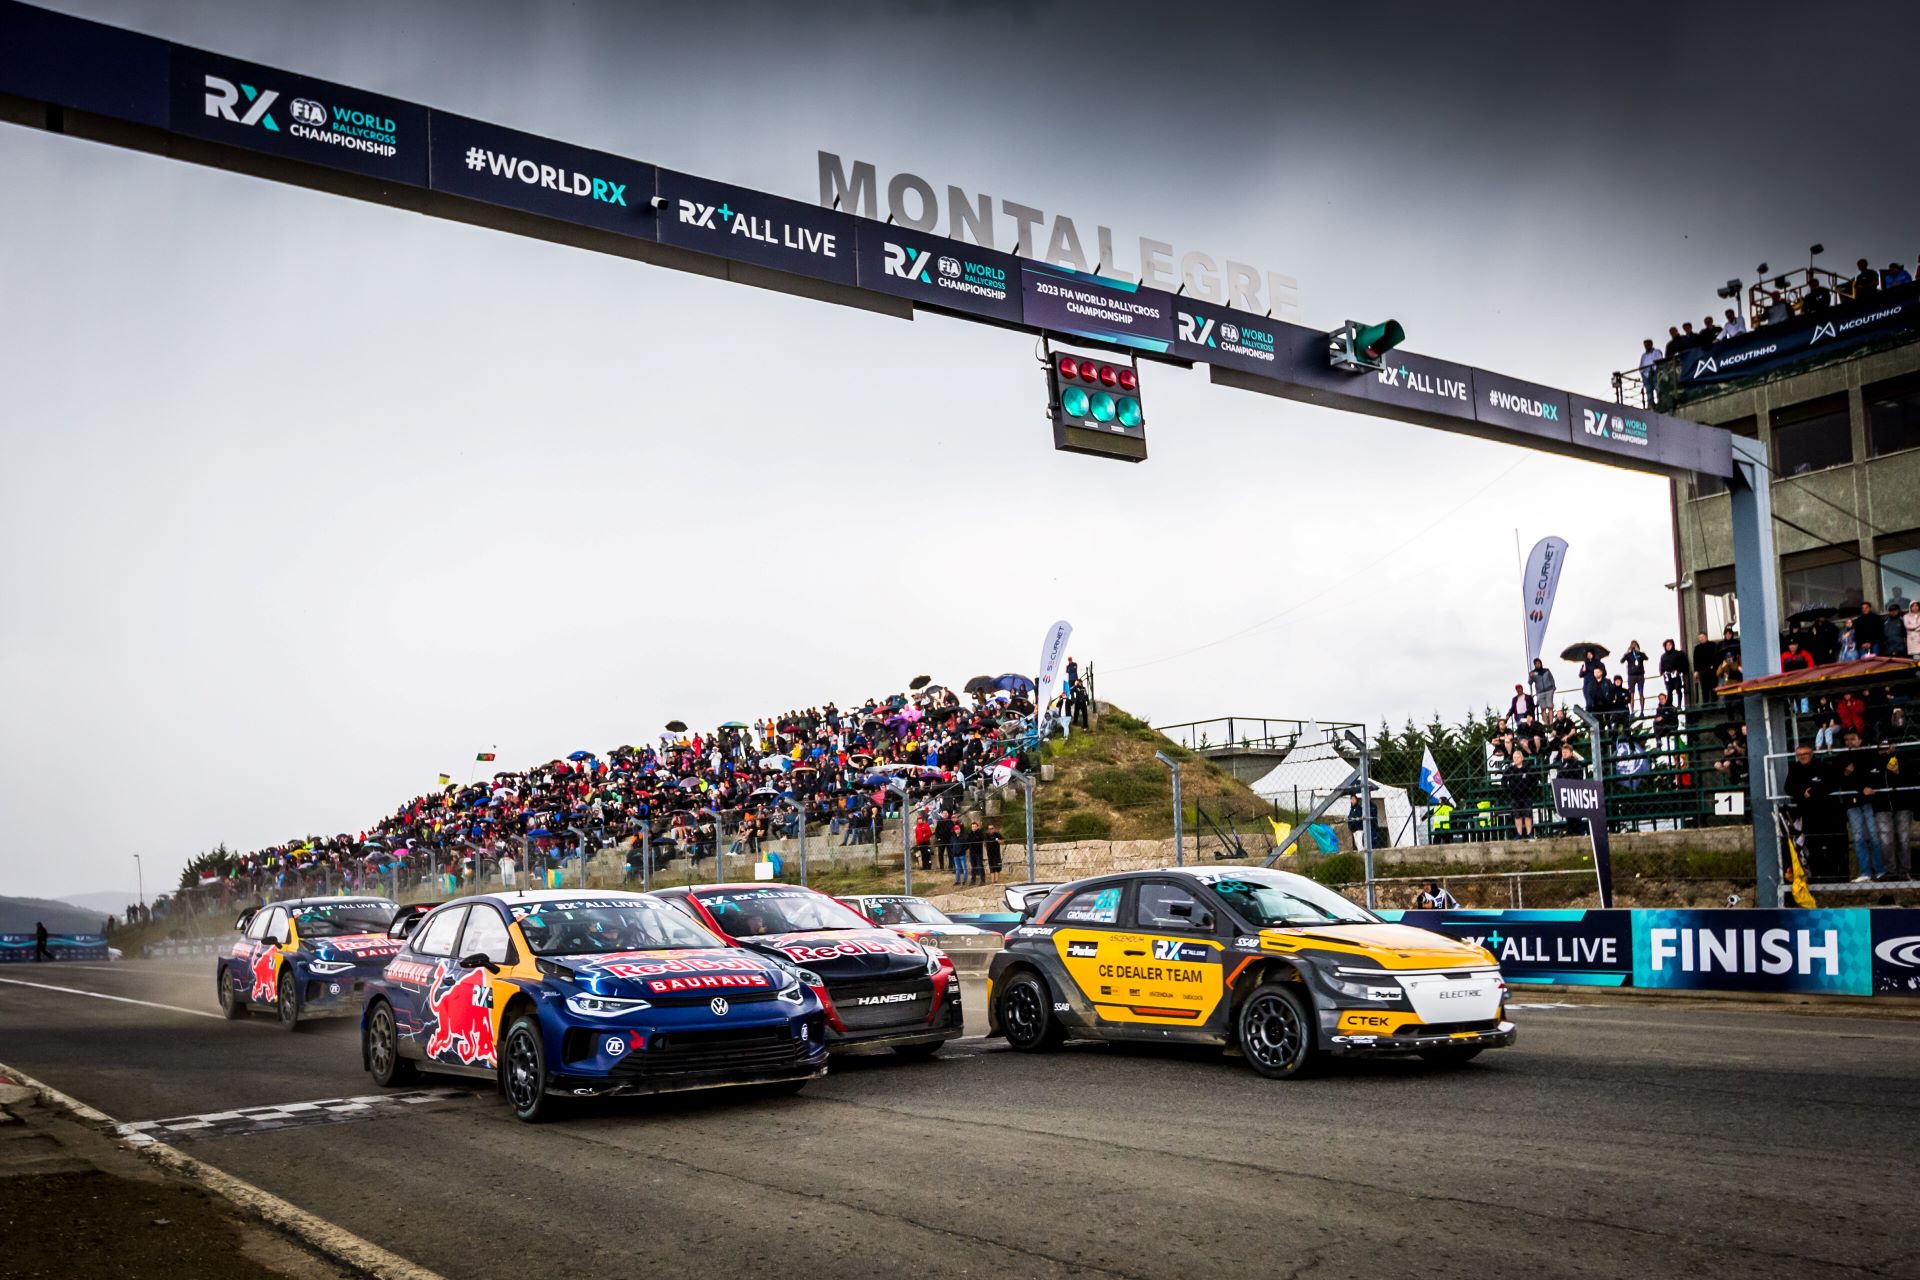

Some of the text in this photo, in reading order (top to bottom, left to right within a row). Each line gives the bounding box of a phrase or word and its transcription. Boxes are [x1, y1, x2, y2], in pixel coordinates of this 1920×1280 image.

[205, 75, 280, 131] RX
[292, 101, 325, 125] FIA
[333, 106, 396, 133] WORLD
[290, 124, 396, 158] CHAMPIONSHIP
[332, 121, 396, 144] RALLYCROSS
[465, 146, 627, 207] #WORLDRX
[731, 212, 778, 244] ALL
[784, 223, 837, 258] LIVE
[817, 149, 1299, 321] MONTALEGRE
[884, 242, 932, 284] RX
[938, 257, 961, 277] FIA
[964, 261, 1006, 281] WORLD
[938, 277, 1007, 300] CHAMPIONSHIP
[964, 273, 1006, 290] RALLYCROSS
[1037, 282, 1160, 319] 2023 FIA WORLD RALLYCROSS
[1066, 302, 1134, 325] CHAMPIONSHIP
[1839, 306, 1903, 333] MCOUTINHO
[1178, 312, 1217, 348] RX
[1221, 325, 1240, 341] FIA
[1241, 327, 1274, 344] WORLD
[1221, 341, 1275, 362] CHAMPIONSHIP
[1241, 337, 1275, 352] RALLYCROSS
[1719, 344, 1777, 369] MCOUTINHO
[1407, 374, 1434, 395] ALL
[1437, 378, 1468, 401] LIVE
[1489, 390, 1559, 422] #WORLDRX
[1584, 408, 1609, 438] RX
[1625, 418, 1647, 432] WORLD
[1611, 431, 1648, 446] CHAMPIONSHIP
[1535, 542, 1555, 605] SECURNET
[1560, 787, 1599, 810] FINISH
[1724, 796, 1733, 812] 1
[613, 900, 644, 908] LIVE
[1095, 888, 1120, 911] 68
[357, 947, 399, 958] BAUH
[783, 944, 863, 964] Red
[865, 941, 928, 957] Bull
[1155, 940, 1184, 961] RX
[1235, 937, 1260, 948] SSAB
[1501, 937, 1550, 963] ALL
[1557, 937, 1617, 963] LIVE
[1650, 928, 1840, 976] FINISH
[604, 955, 766, 979] Red Bull
[1099, 964, 1203, 983] CE DEALER TEAM
[650, 974, 768, 993] BAUHAUS
[1439, 988, 1482, 999] ELECTRIC
[858, 993, 917, 1005] HANSEN
[1053, 1002, 1071, 1012] SSAB
[1347, 1015, 1389, 1027] CTEK
